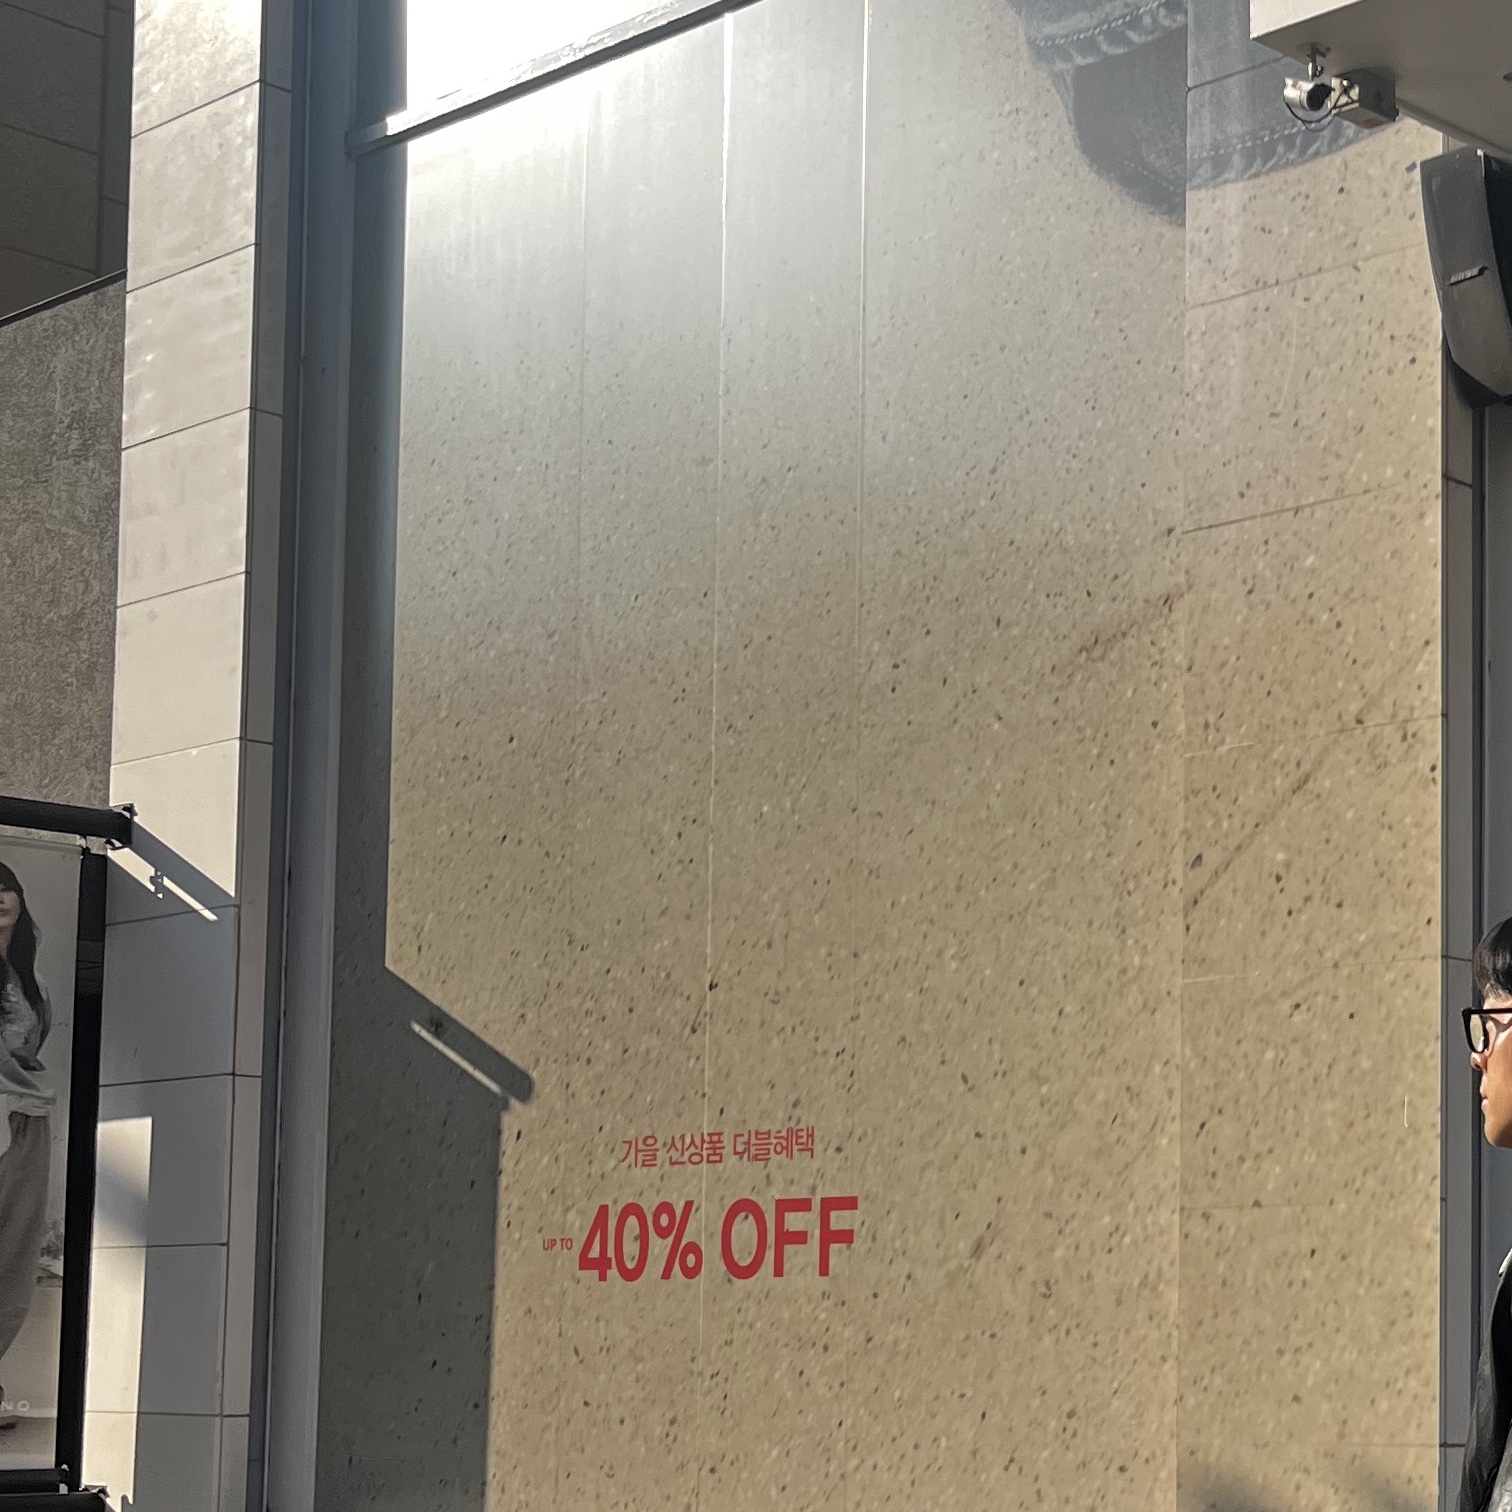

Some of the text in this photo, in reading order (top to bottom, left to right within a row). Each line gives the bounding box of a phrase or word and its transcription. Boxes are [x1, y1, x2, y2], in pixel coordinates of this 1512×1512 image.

[621, 1126, 816, 1168] 가을 신상품 더블혜택
[542, 1196, 859, 1283] UP TO 40% OFF
